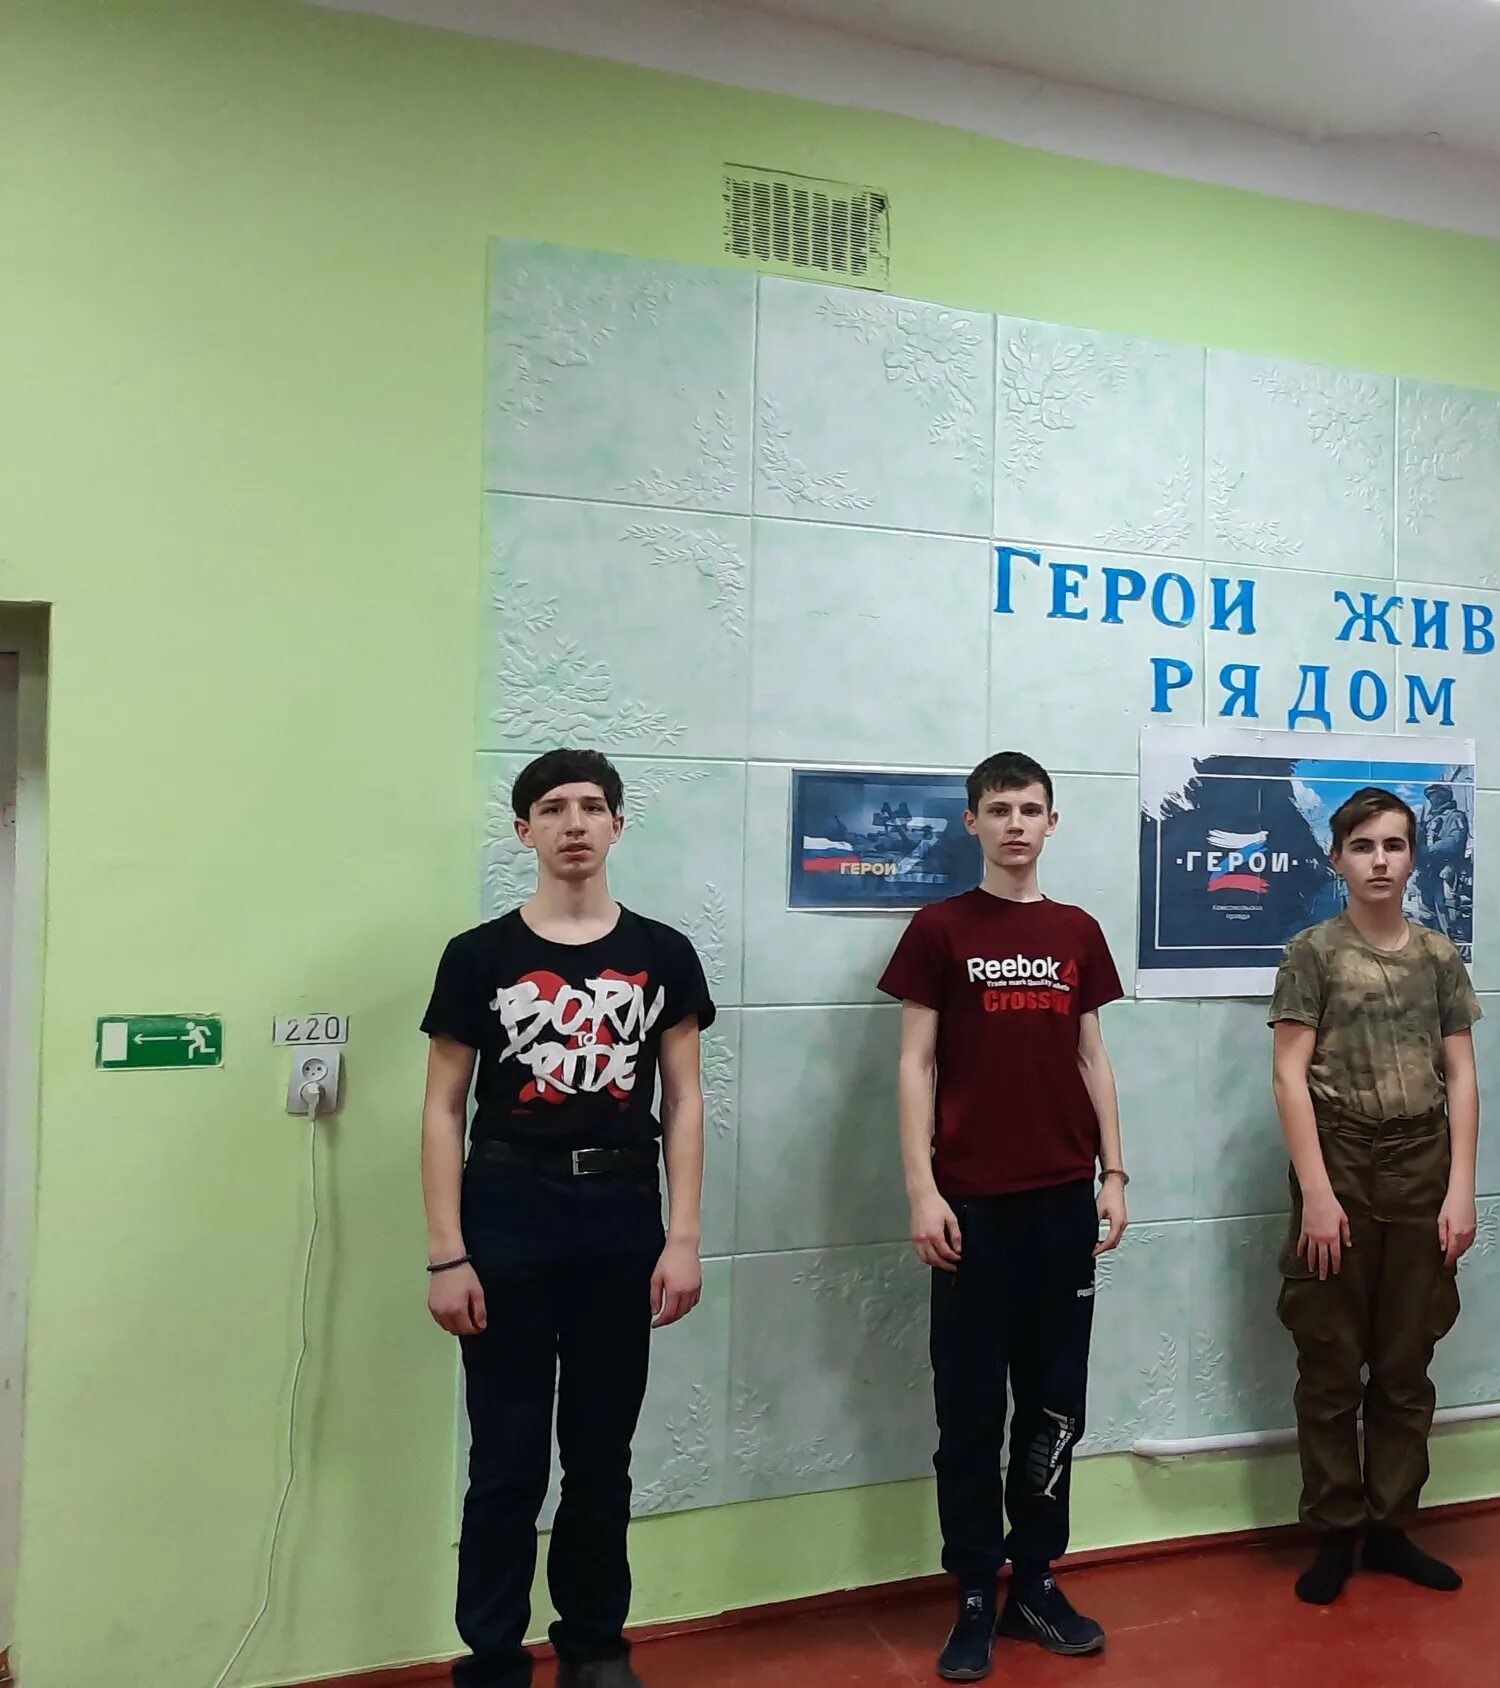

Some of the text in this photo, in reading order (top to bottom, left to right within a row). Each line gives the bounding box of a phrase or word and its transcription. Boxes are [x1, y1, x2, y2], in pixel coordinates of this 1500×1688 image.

[993, 545, 1256, 634] ГЕРОИ
[1149, 657, 1456, 732] РЯДОМ
[840, 862, 897, 876] ГЕРОИ
[966, 954, 1061, 983] Reebok
[285, 1016, 341, 1041] 220
[489, 977, 666, 1063] BORN
[572, 1031, 597, 1047] TO
[516, 1041, 640, 1095] RIDE
